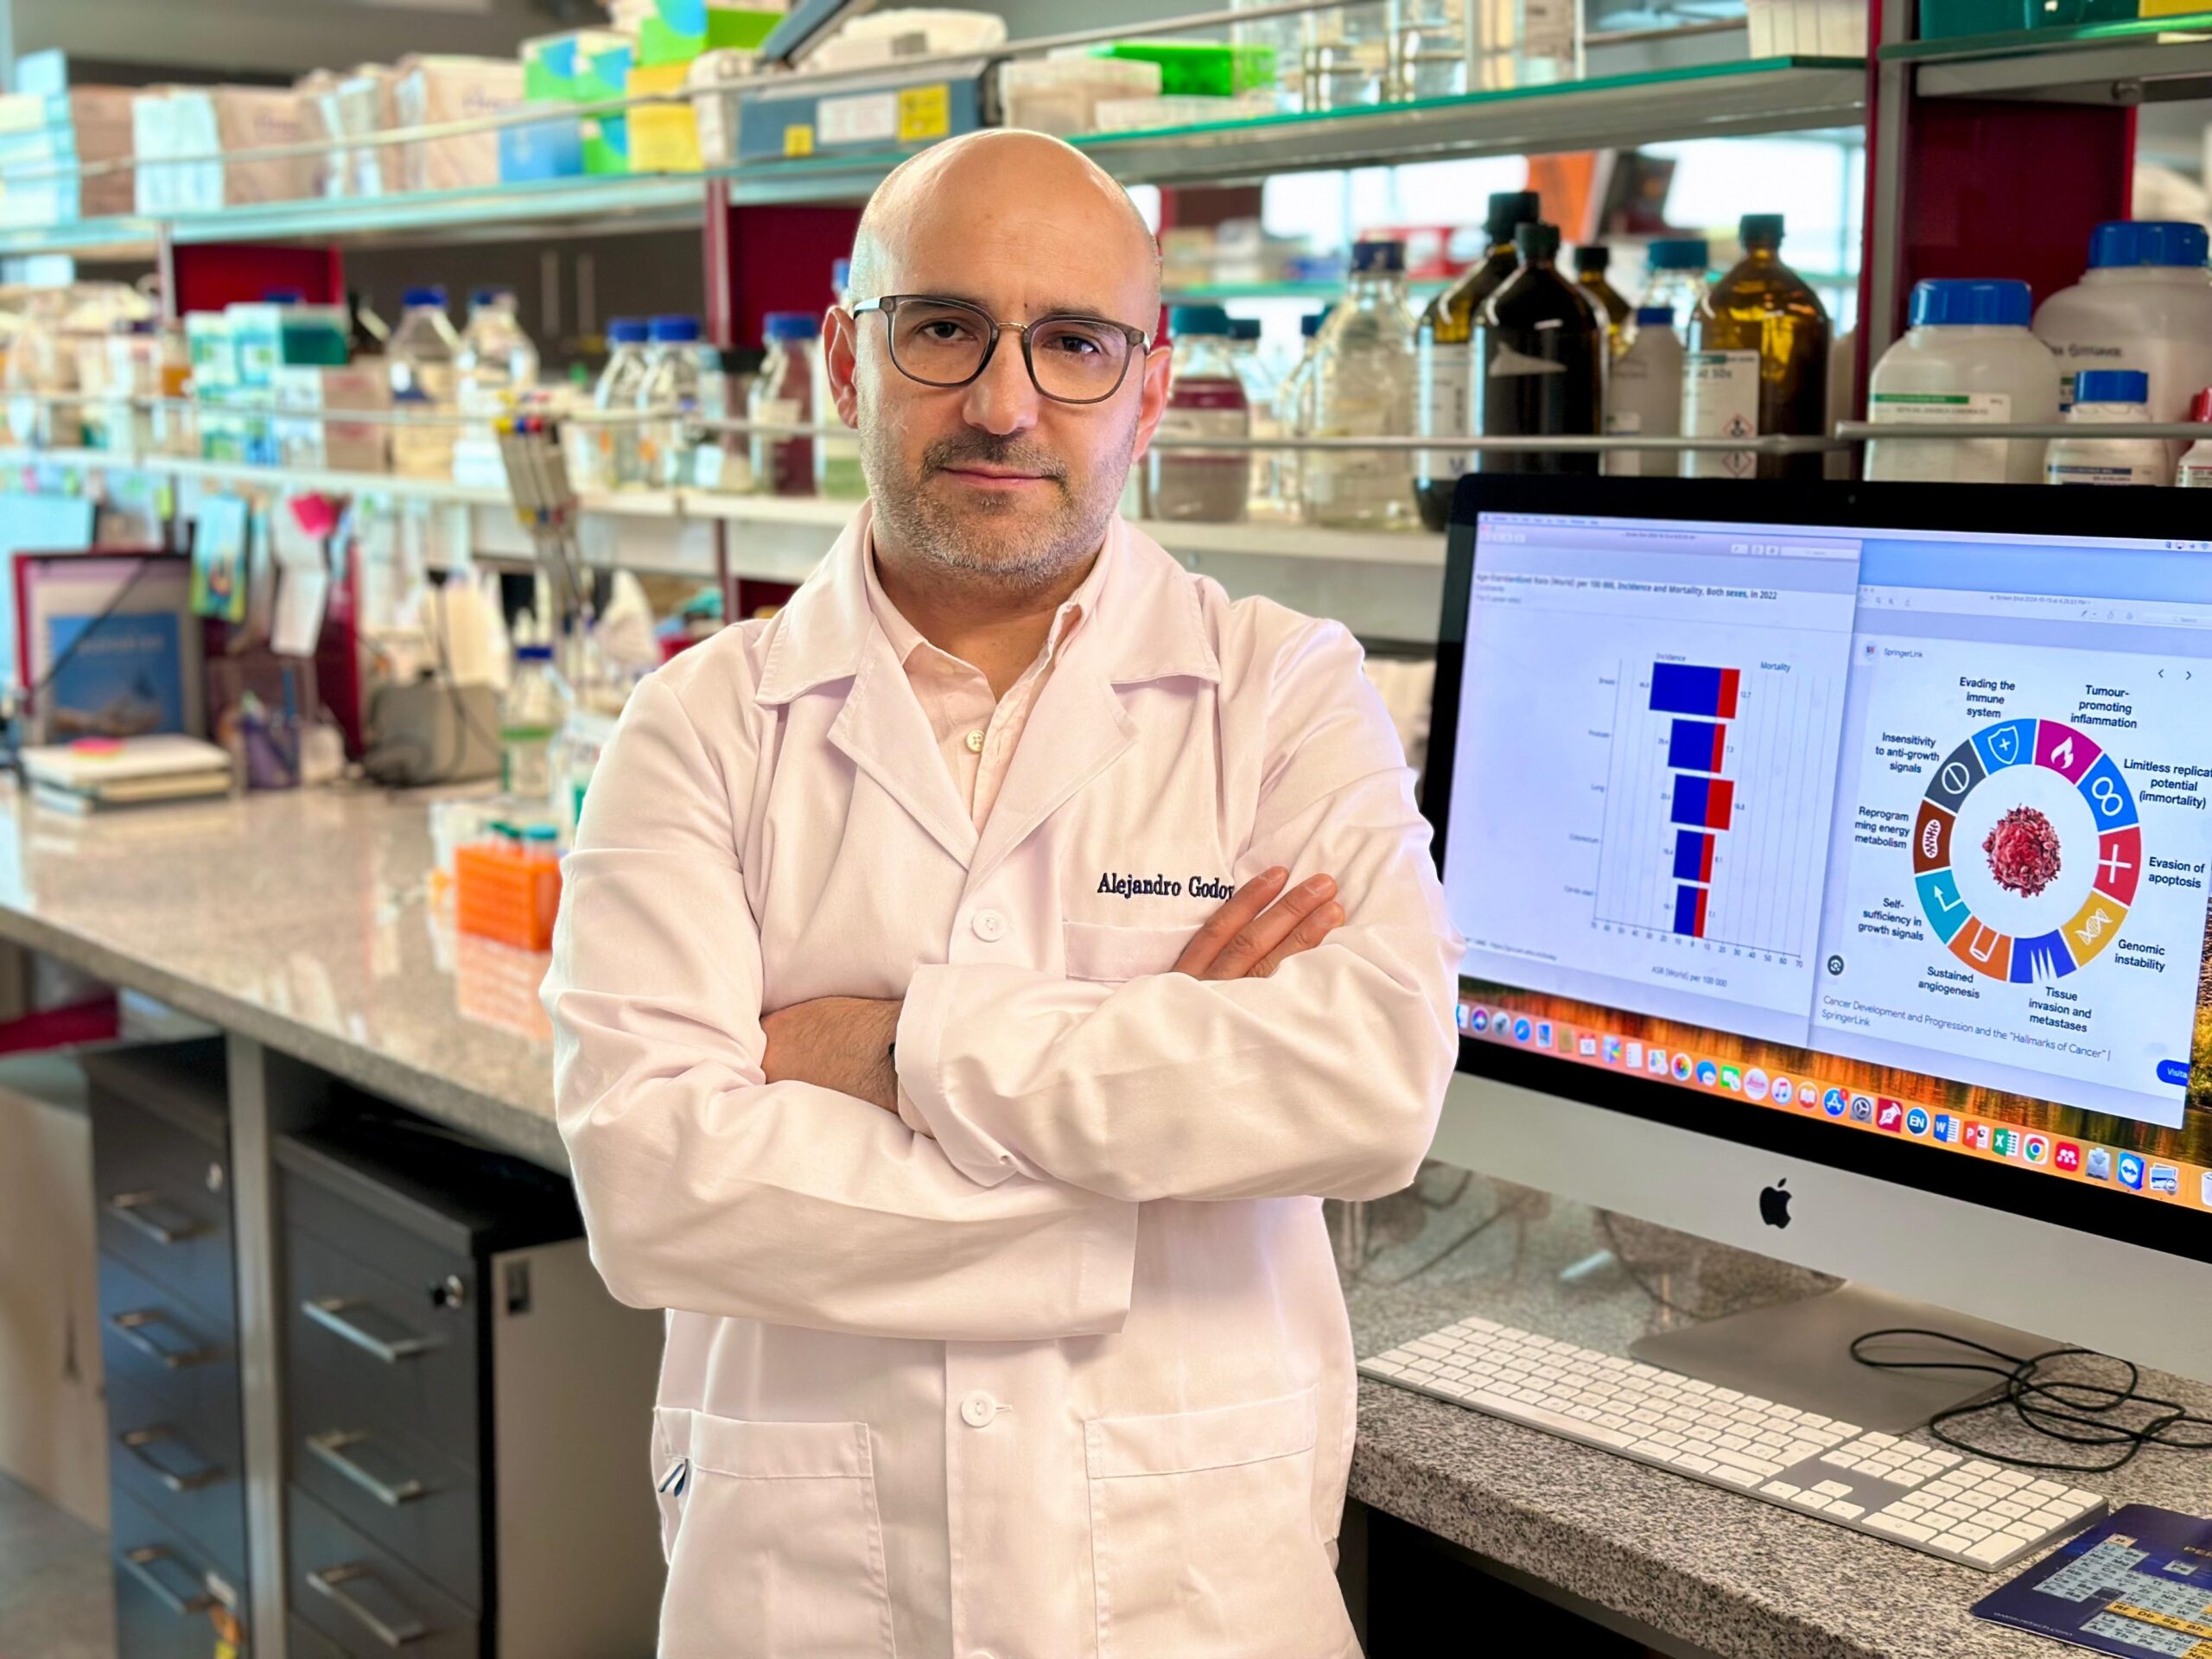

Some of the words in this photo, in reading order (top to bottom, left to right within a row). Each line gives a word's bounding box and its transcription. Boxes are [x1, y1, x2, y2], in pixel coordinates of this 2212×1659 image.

[1618, 582, 1651, 592] Incidence
[1654, 584, 1667, 593] and
[1707, 588, 1724, 596] Both
[1726, 589, 1749, 598] sexes,
[1751, 589, 1758, 598] in
[1759, 591, 1777, 600] 2022
[1656, 652, 1687, 662] Incidence
[1884, 648, 1923, 658] SpringerLink
[1761, 661, 1790, 673] Mortality
[1960, 676, 1998, 691] Evading
[1999, 681, 2015, 690] the
[2085, 684, 2129, 698] Tumour-
[1967, 691, 2005, 704] immune
[1967, 708, 2001, 718] system
[2079, 700, 2133, 715] promoting
[2070, 713, 2138, 729] inflammation
[1882, 732, 1936, 749] Insensitivity
[1875, 747, 1885, 755] to
[1887, 748, 1939, 762] anti-growth
[1889, 762, 1922, 773] signals
[2124, 759, 2171, 773] Limitless
[2150, 778, 2198, 791] potential
[2139, 790, 2207, 810] (immortality)
[1859, 805, 1910, 821] Reprogram
[1854, 821, 1877, 833] ming
[1878, 823, 1910, 836] energy
[1854, 835, 1907, 849] metabolism
[2149, 856, 2191, 872] Evasion
[2193, 862, 2205, 873] of
[1097, 873, 1182, 899] Alejandro
[2148, 874, 2202, 888] apoptosis
[1883, 897, 1904, 909] Self-
[1863, 910, 1911, 926] sufficiency
[1913, 916, 1922, 926] in
[1858, 923, 1889, 935] growth
[1891, 928, 1923, 941] signals
[2118, 938, 2165, 956] Genomic
[1718, 945, 1726, 954] 20
[1796, 959, 1803, 968] 70
[2114, 952, 2165, 973] instability
[1665, 968, 1689, 981] (World)
[1690, 973, 1701, 983] per
[1702, 975, 1714, 985] 100
[1716, 978, 1728, 988] 000
[1927, 966, 1974, 983] Sustained
[1918, 980, 1980, 999] angiogenesis
[2046, 986, 2077, 1001] Tissue
[2029, 998, 2070, 1015] invasion
[2072, 1007, 2092, 1019] and
[1821, 1009, 1871, 1027] SpringerLink
[1823, 995, 1852, 1007] Cancer
[1853, 1001, 1906, 1020] Development
[1908, 1013, 1923, 1023] and
[1924, 1014, 1974, 1033] Progression
[1975, 1027, 1991, 1037] and
[1993, 1029, 2008, 1040] the
[2057, 1042, 2067, 1051] of
[2029, 1014, 2088, 1033] metastases
[1910, 1116, 1925, 1128] EN
[1936, 1122, 1946, 1134] W
[1967, 1128, 1974, 1140] P
[1994, 1135, 2004, 1147] X
